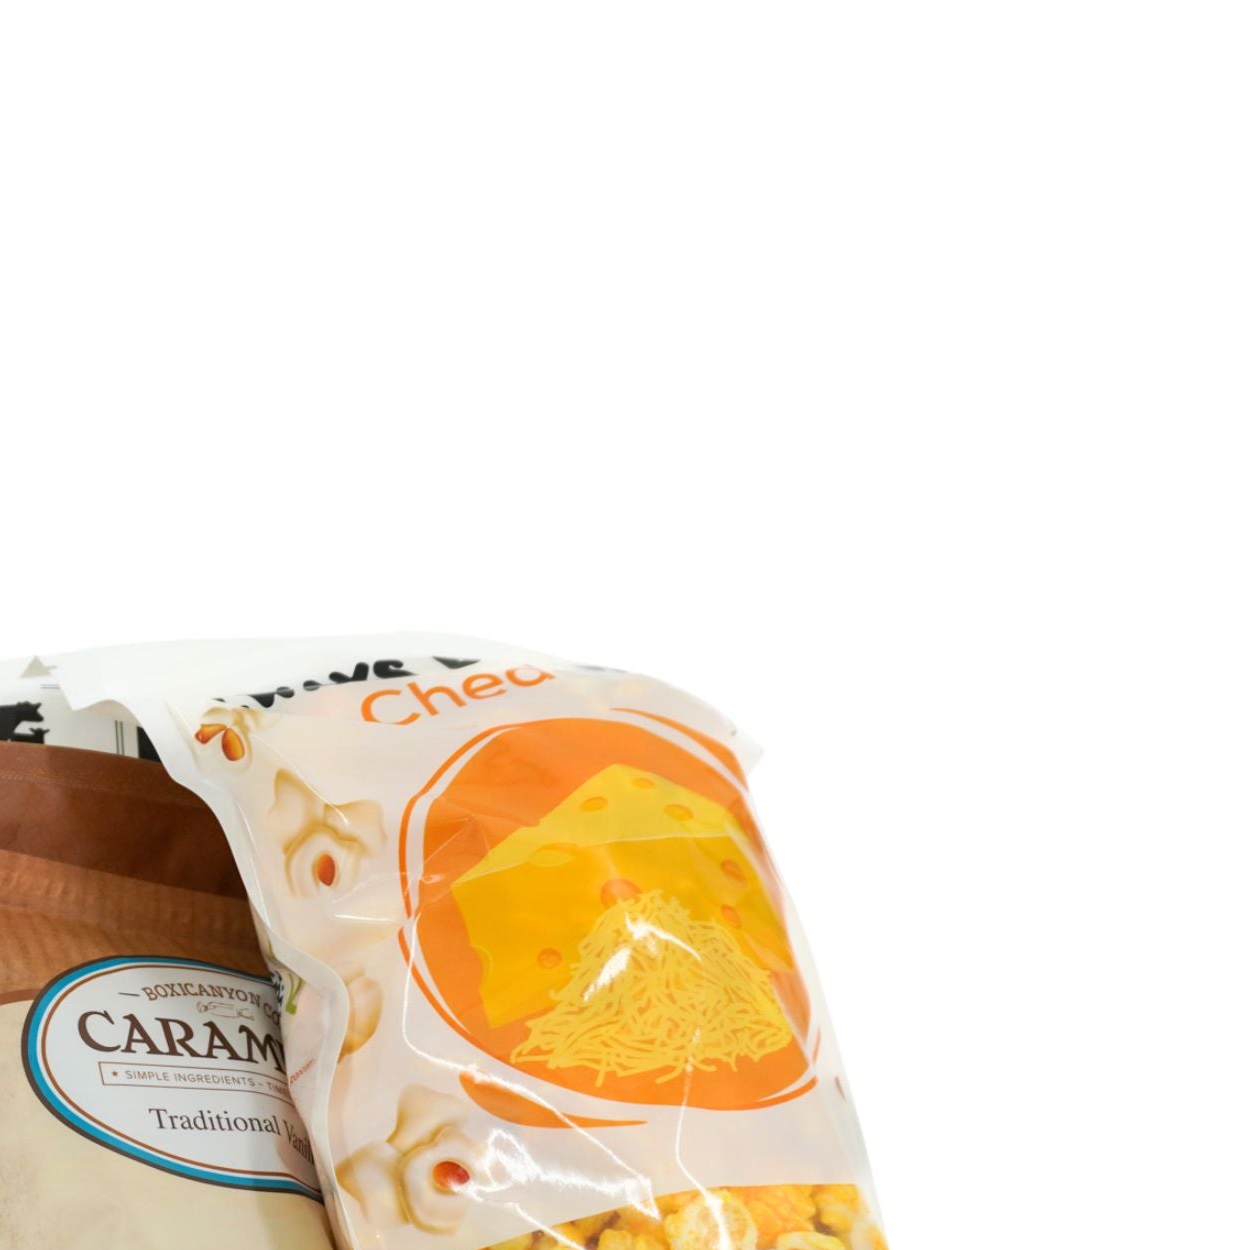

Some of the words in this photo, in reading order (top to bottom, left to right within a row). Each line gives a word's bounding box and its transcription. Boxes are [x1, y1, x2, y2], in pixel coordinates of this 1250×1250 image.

[78, 1010, 284, 1074] CARAM
[125, 1070, 170, 1082] SIMPLE
[174, 1073, 256, 1087] INGREDIENTS
[149, 1108, 280, 1135] Traditional
